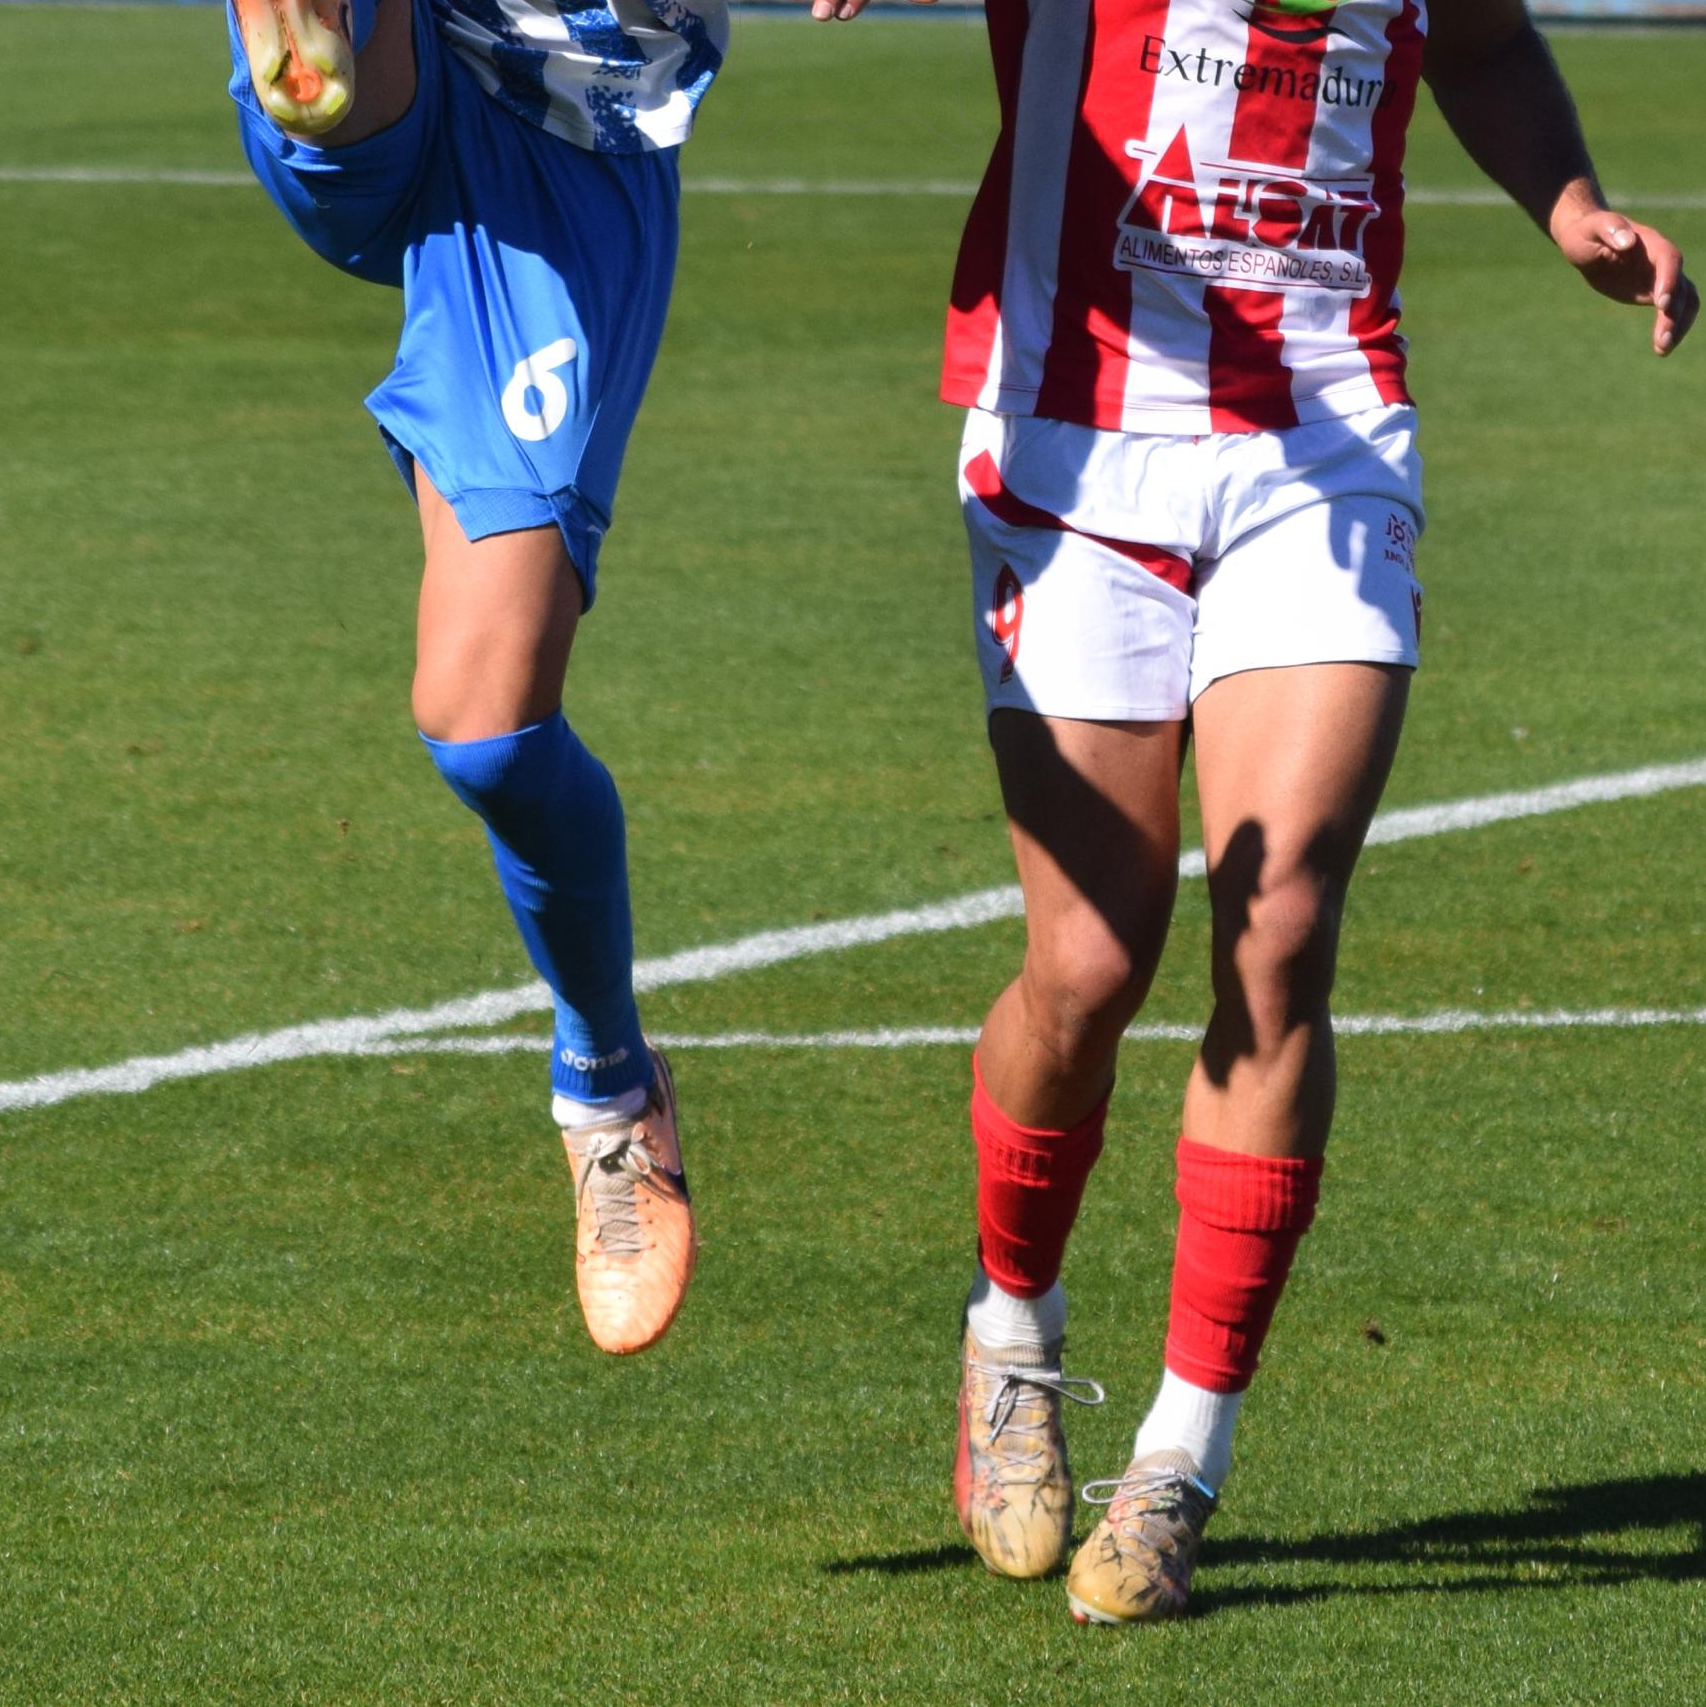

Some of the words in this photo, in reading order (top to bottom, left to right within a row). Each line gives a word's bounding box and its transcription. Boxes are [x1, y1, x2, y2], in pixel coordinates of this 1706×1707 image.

[1138, 34, 1398, 109] Extremadura
[1119, 236, 1223, 271] ALIMENTOS
[1228, 251, 1334, 283] ESPAÑOLES,
[501, 337, 578, 442] 6
[990, 560, 1025, 685] 9
[559, 1046, 631, 1072] Joma
